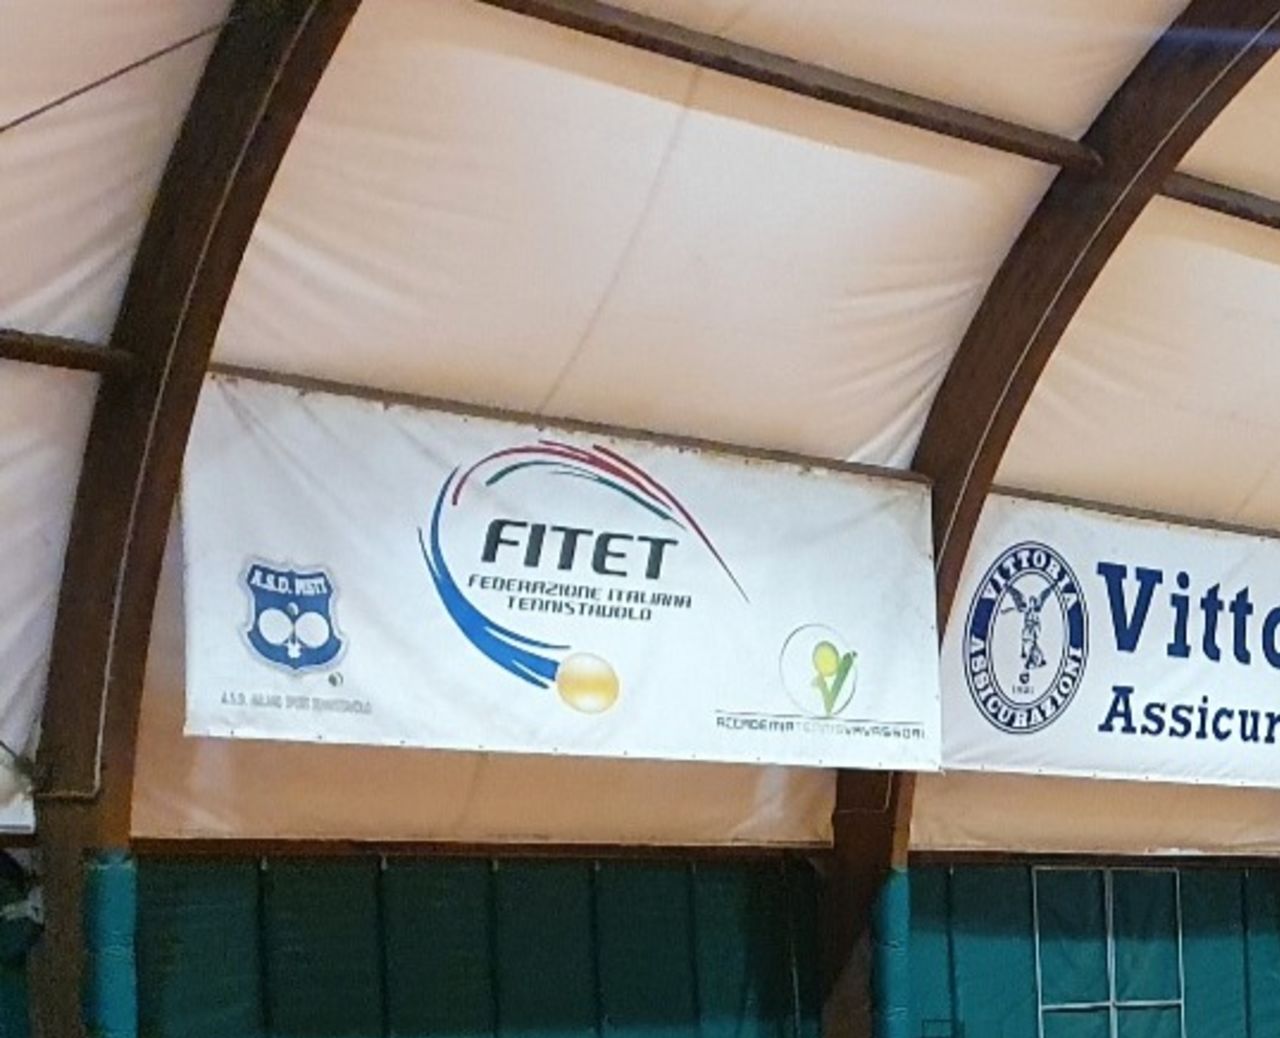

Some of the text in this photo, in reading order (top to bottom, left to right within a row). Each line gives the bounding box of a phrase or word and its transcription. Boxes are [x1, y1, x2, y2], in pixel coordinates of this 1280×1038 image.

[481, 519, 679, 580] FITET
[981, 549, 1078, 611] VITTORIA
[468, 573, 692, 608] FEDERAZIONE ITALIANA
[507, 595, 652, 621] TENNISTAVOLO
[970, 635, 1083, 727] ASSICURAZIONI
